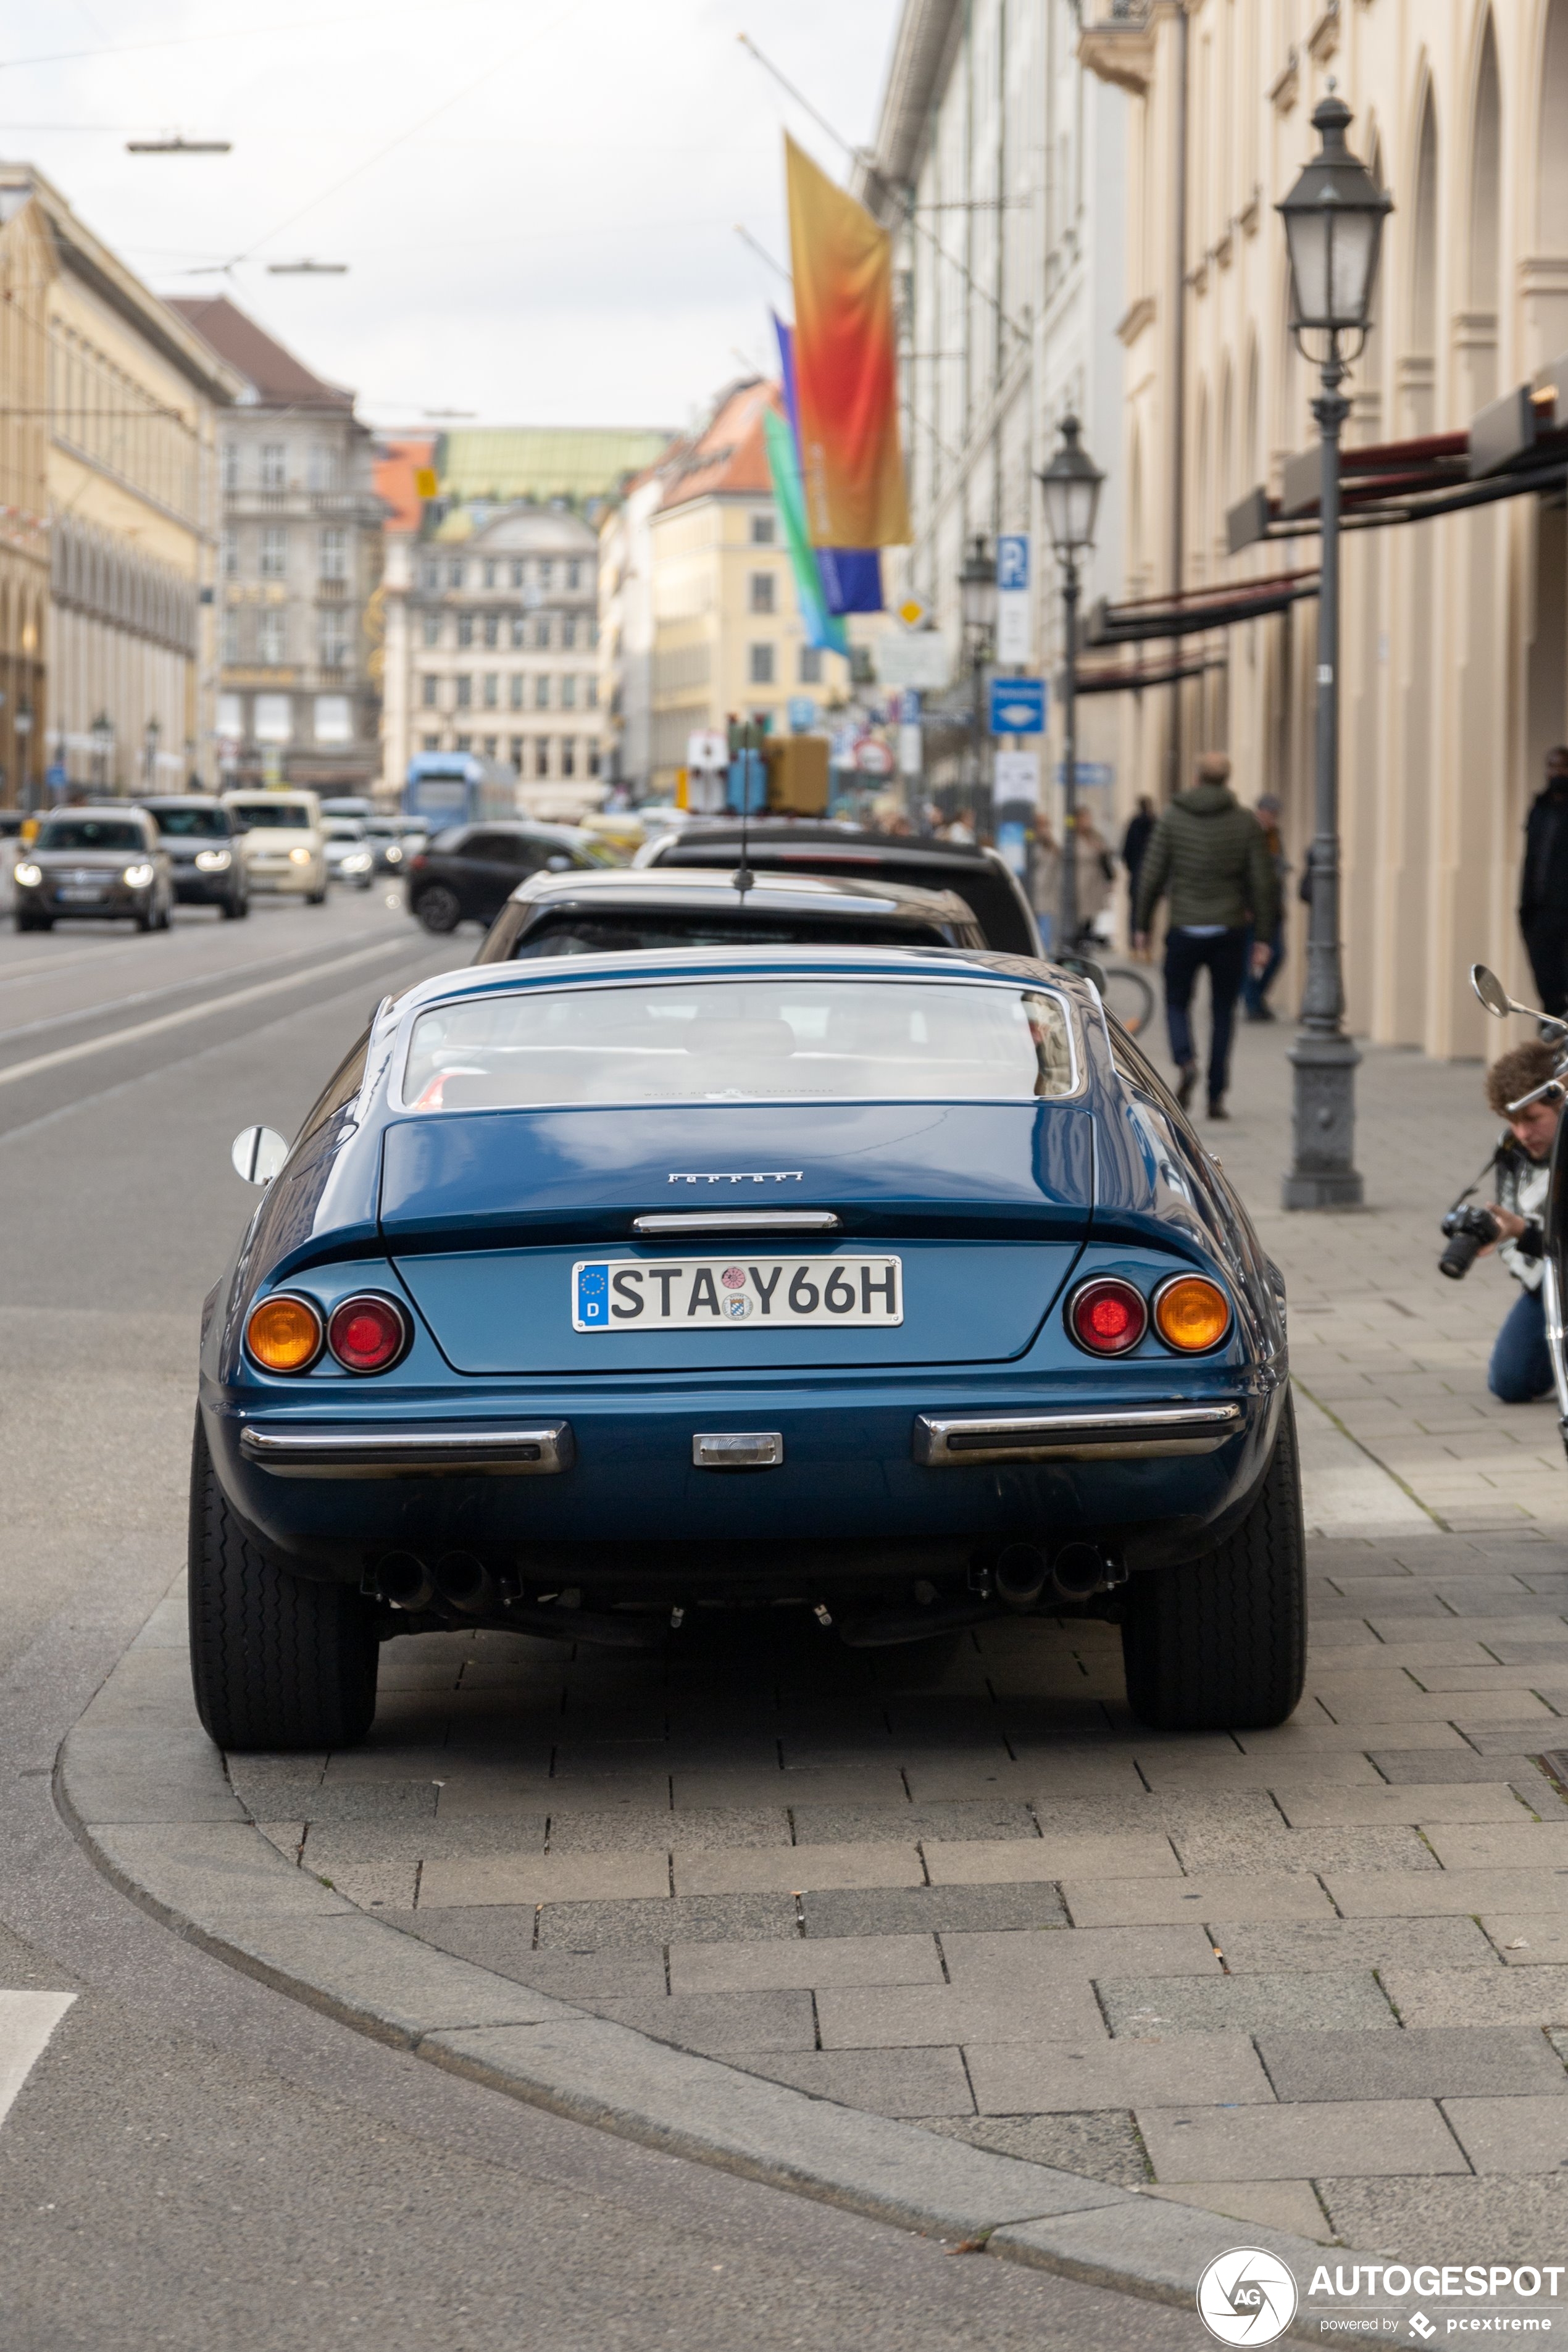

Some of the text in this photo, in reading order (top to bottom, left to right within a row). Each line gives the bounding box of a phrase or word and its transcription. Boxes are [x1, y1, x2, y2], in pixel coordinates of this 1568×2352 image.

[667, 1171, 803, 1183] Ferrari
[611, 1267, 721, 1319] STA
[749, 1266, 896, 1314] Y66H
[587, 1303, 599, 1317] D
